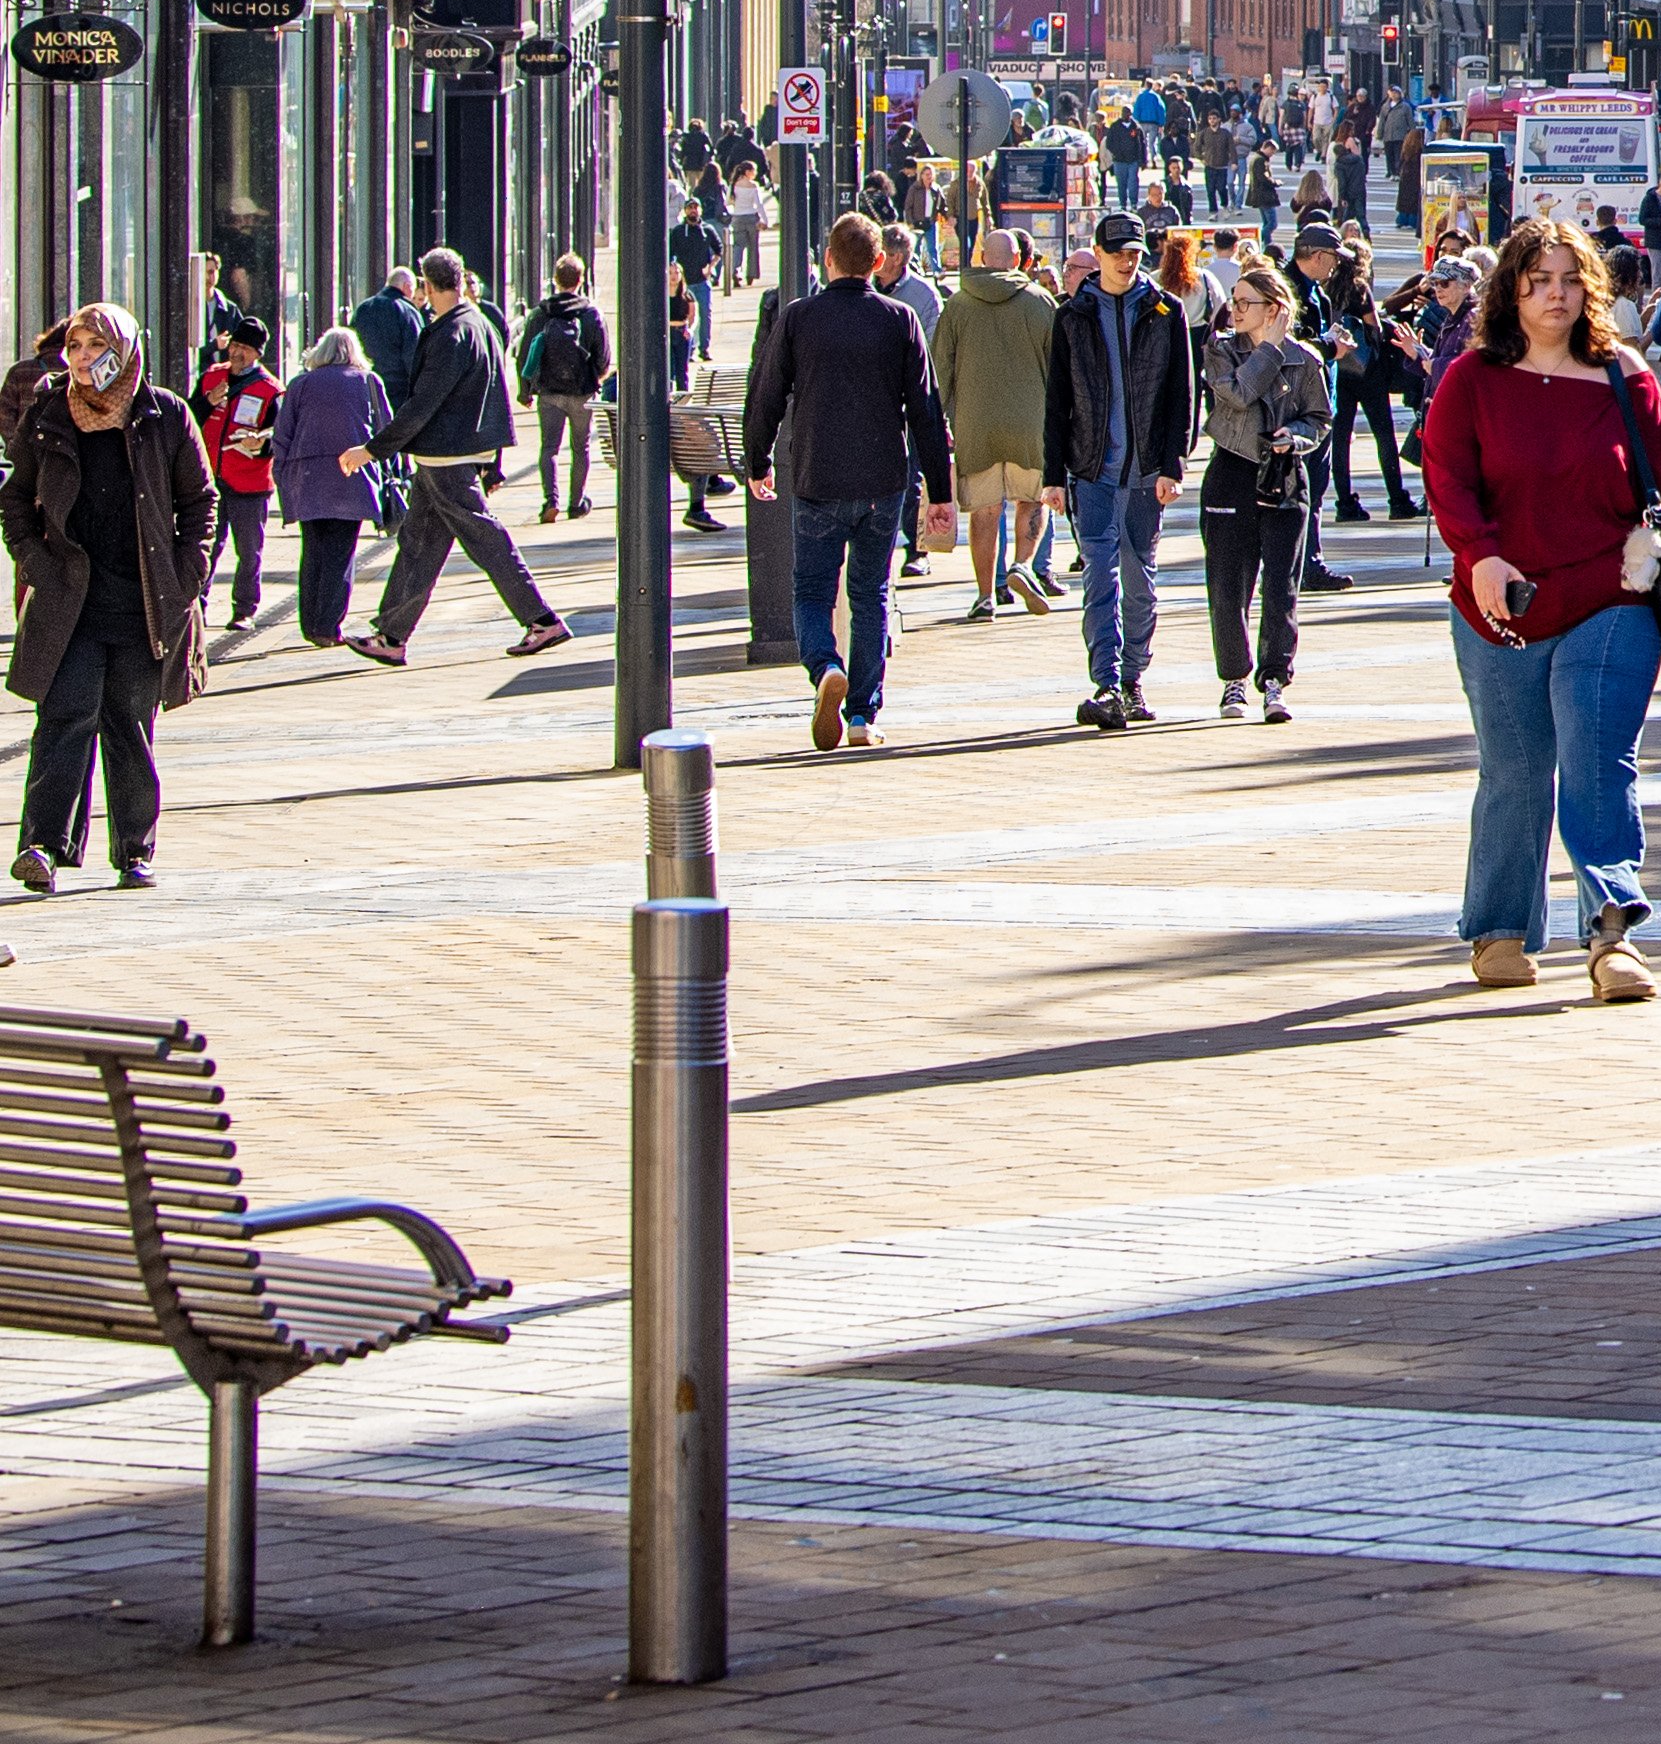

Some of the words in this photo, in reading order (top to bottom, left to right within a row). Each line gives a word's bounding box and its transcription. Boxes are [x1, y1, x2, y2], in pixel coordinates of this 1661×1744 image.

[212, 2, 291, 16] NICHOLS
[34, 30, 118, 46] MONICA
[31, 47, 121, 64] VINADER
[425, 48, 480, 58] BOODLES
[988, 63, 1045, 72] VIADUCT
[1540, 104, 1556, 113] MR
[1559, 104, 1598, 113] WHIPPY
[1601, 104, 1633, 113] LEEDS
[786, 118, 803, 126] Don't
[803, 118, 818, 128] drop
[1549, 126, 1583, 135] DELICIOUS
[1584, 126, 1594, 134] ICE
[1595, 126, 1619, 134] CREAM
[1553, 145, 1584, 154] FRESHLY
[1585, 145, 1615, 153] GROUND
[1569, 154, 1597, 163] COFFEE
[1532, 175, 1582, 183] CAPPUCCINO
